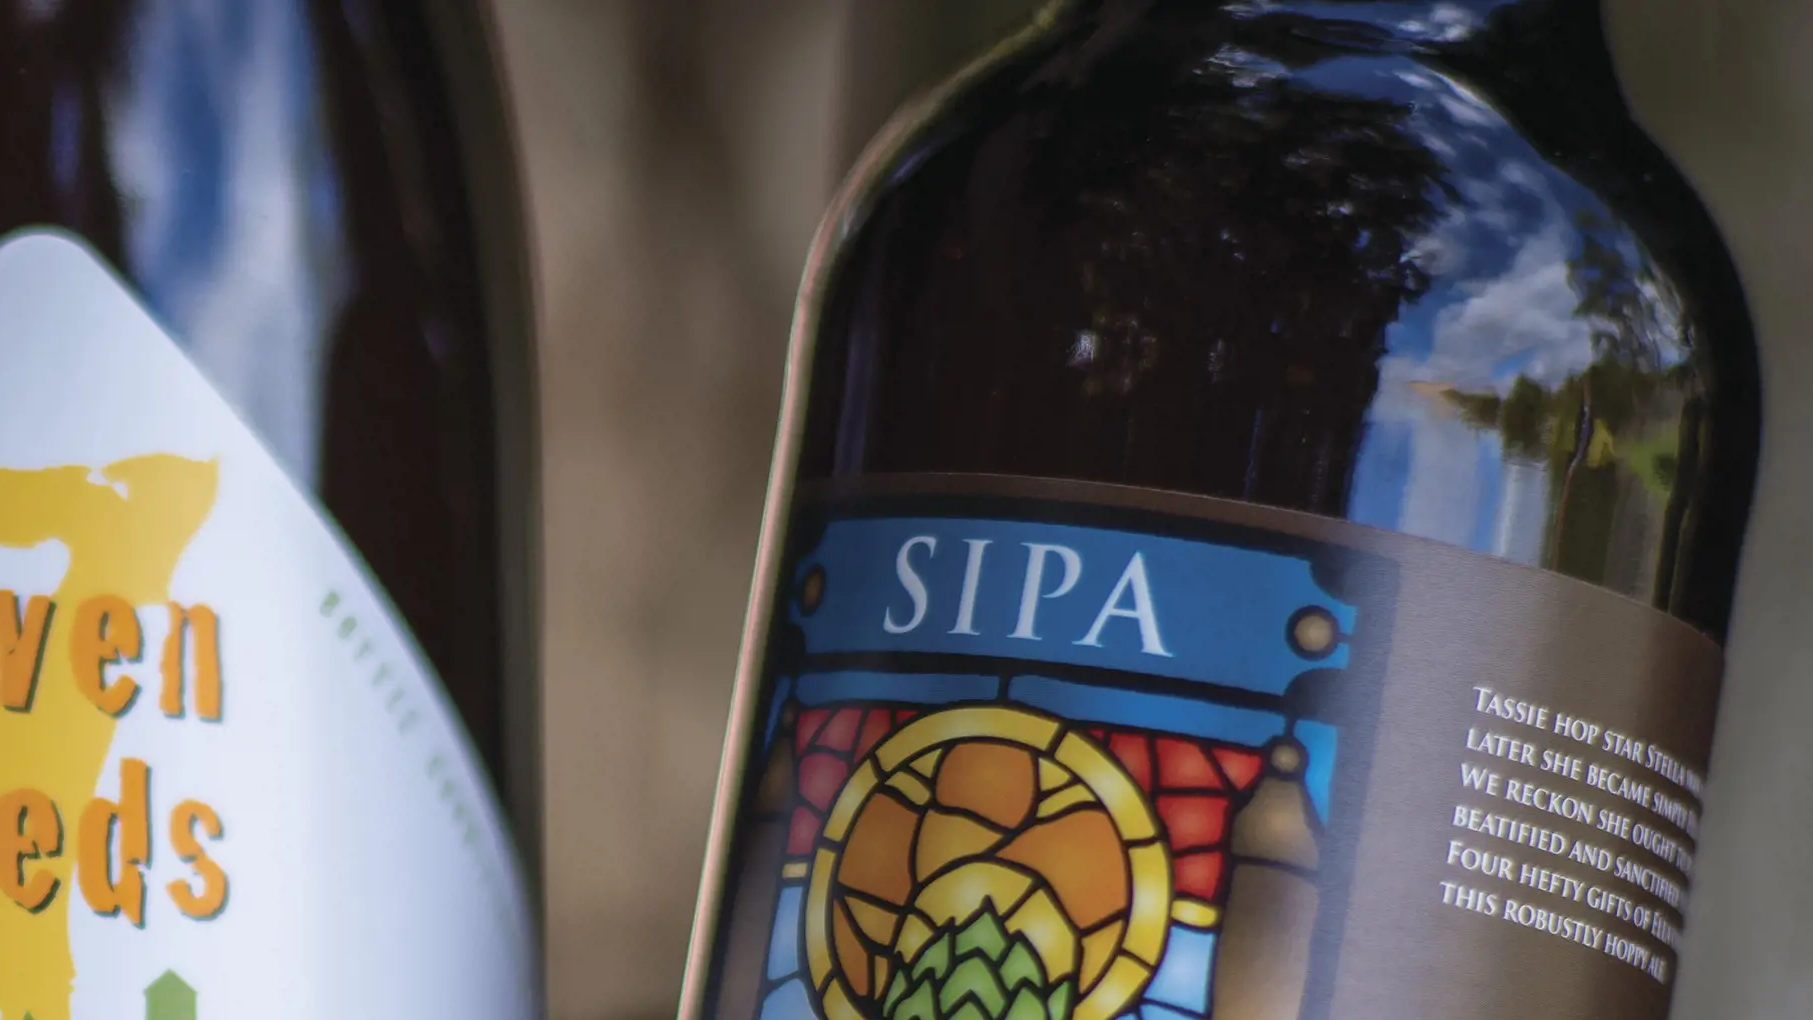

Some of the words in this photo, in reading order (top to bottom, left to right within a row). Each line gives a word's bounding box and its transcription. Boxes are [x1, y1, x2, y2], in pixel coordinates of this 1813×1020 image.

[883, 535, 1174, 657] SIPA
[1465, 727, 1536, 767] LATER
[1540, 749, 1583, 782] SHE
[1586, 764, 1650, 809] BECAME
[1473, 685, 1550, 730] TASSIE
[1553, 712, 1600, 746] HOP
[1602, 730, 1643, 765] STAR
[1452, 804, 1566, 855] BEATIFIED
[1568, 839, 1611, 872] AND
[1460, 762, 1500, 797] WE
[1506, 779, 1595, 825] RECKON
[1596, 808, 1631, 840] SHE
[1632, 823, 1676, 864] OUGHT
[1440, 880, 1498, 917] THIS
[1503, 898, 1604, 951] ROBUSTLY
[1604, 932, 1649, 971] HOPPY
[1446, 839, 1514, 882] FOUR
[1519, 862, 1585, 903] HEFTY
[1586, 886, 1632, 922] GIFTS
[1633, 905, 1652, 931] OF
